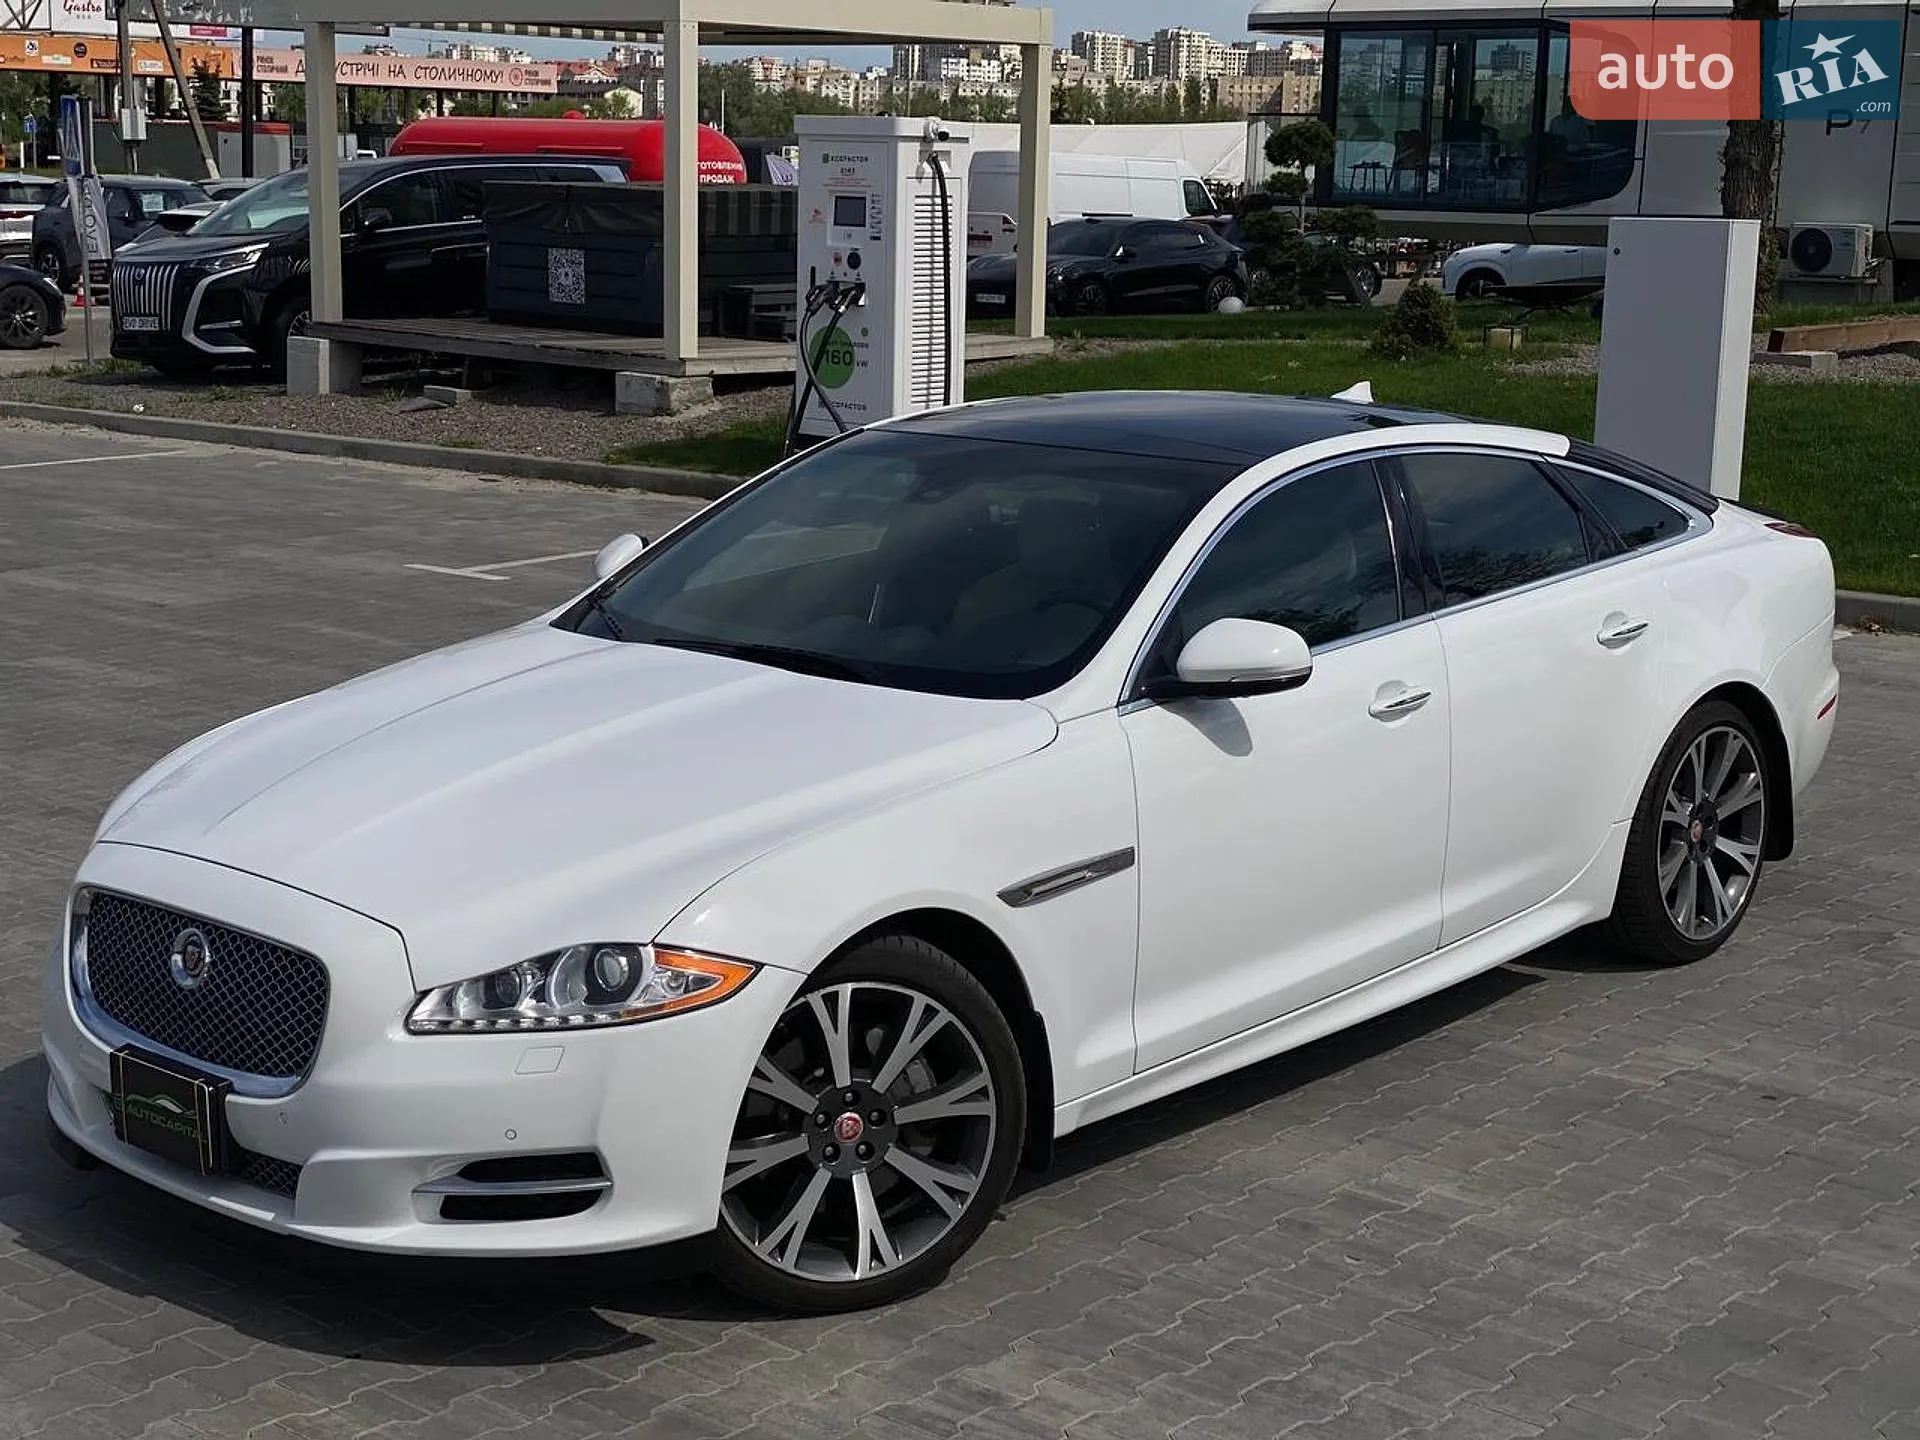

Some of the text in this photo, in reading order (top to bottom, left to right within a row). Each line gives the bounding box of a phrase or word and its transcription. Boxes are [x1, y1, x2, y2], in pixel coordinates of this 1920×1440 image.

[388, 63, 406, 79] НА
[414, 65, 504, 83] СТОЛИЧНОМУ!
[700, 173, 735, 184] ПРОДАЖ
[826, 348, 853, 367] 160
